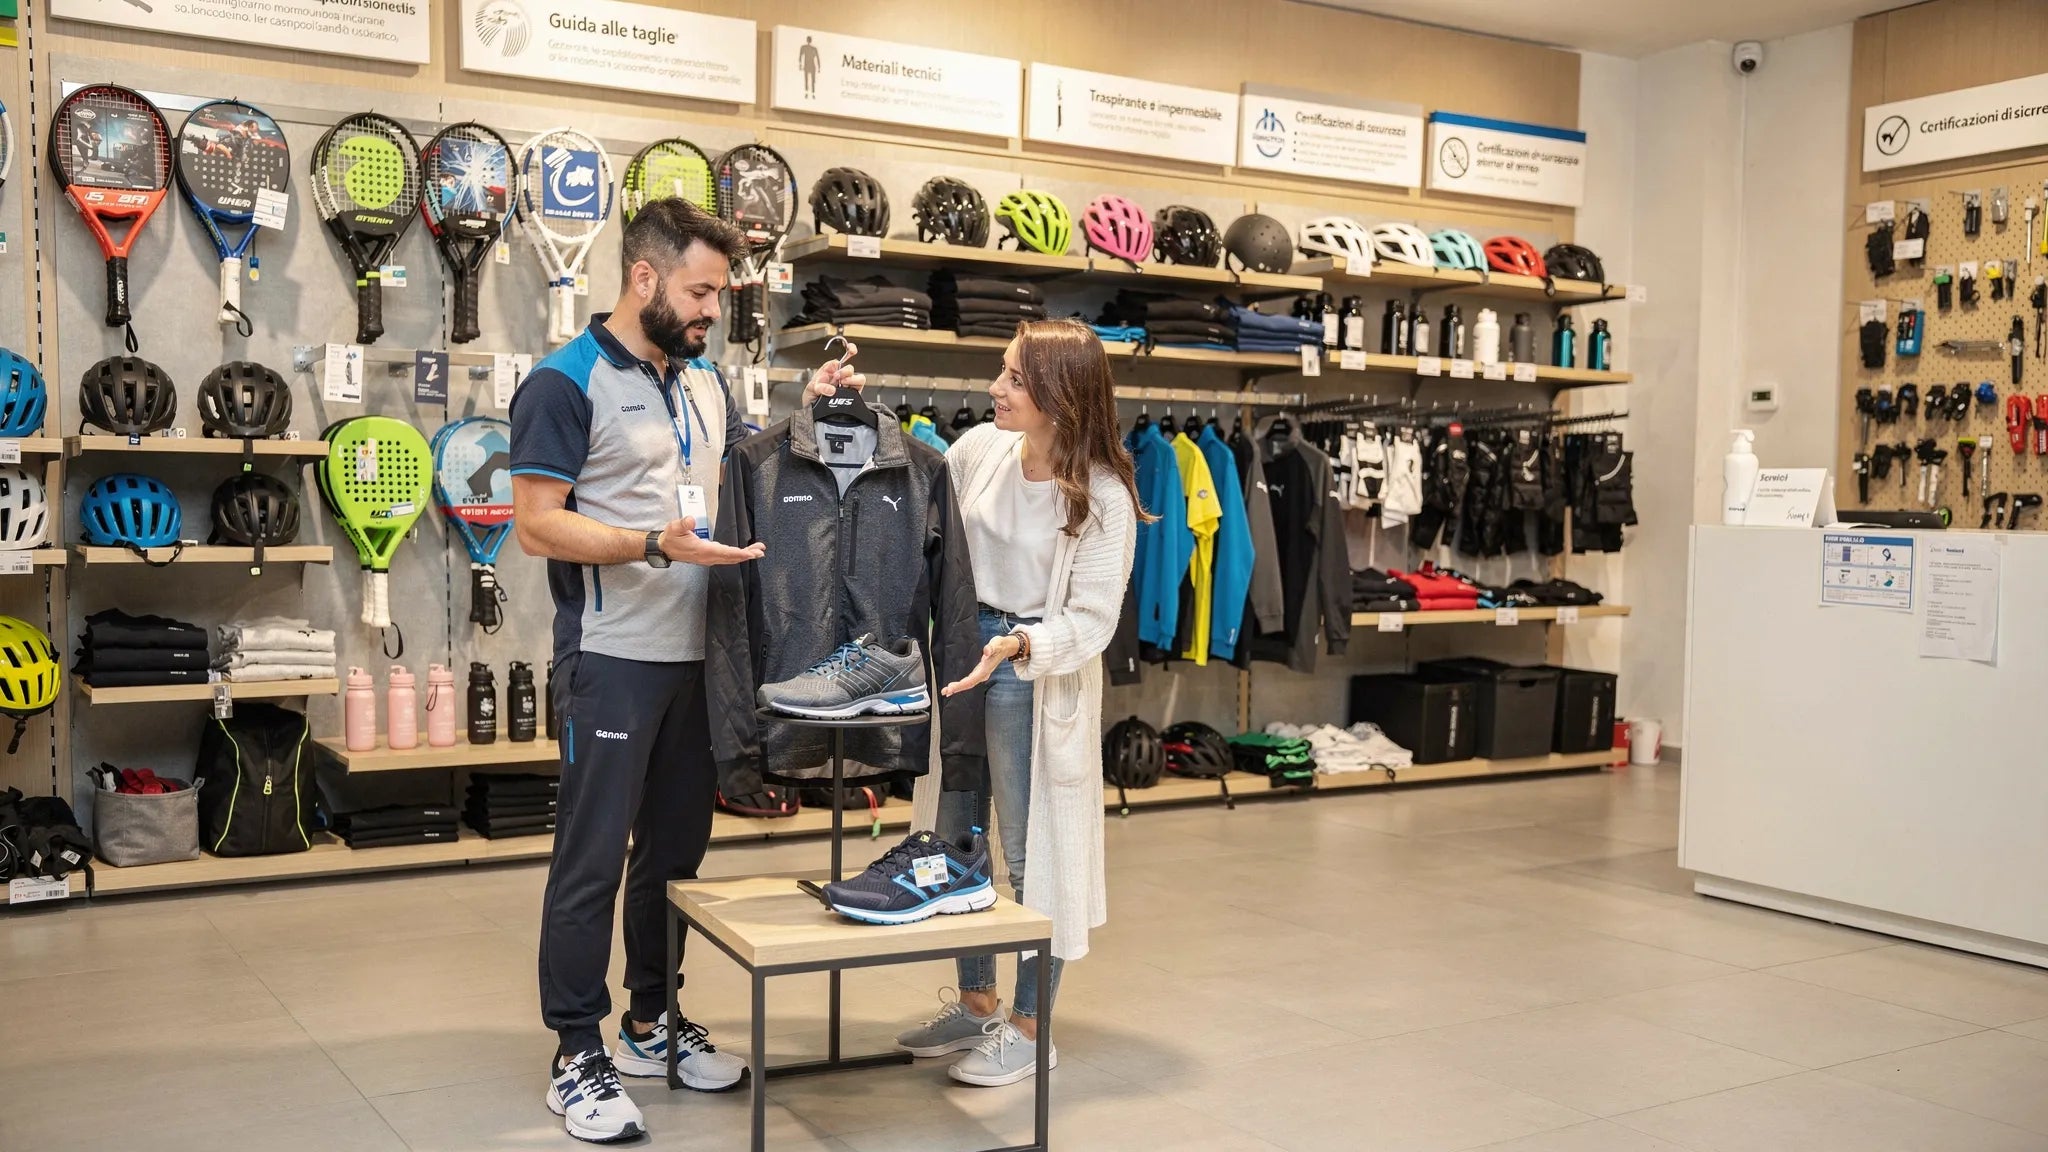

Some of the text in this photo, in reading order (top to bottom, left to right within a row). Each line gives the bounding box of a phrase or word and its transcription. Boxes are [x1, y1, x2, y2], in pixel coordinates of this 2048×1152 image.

[549, 13, 596, 33] Guida
[601, 20, 628, 37] alle
[842, 53, 942, 82] Materiali tecnici
[1090, 89, 1147, 109] Traspirante
[1920, 110, 1999, 134] Certificazioni
[2001, 107, 2012, 121] di
